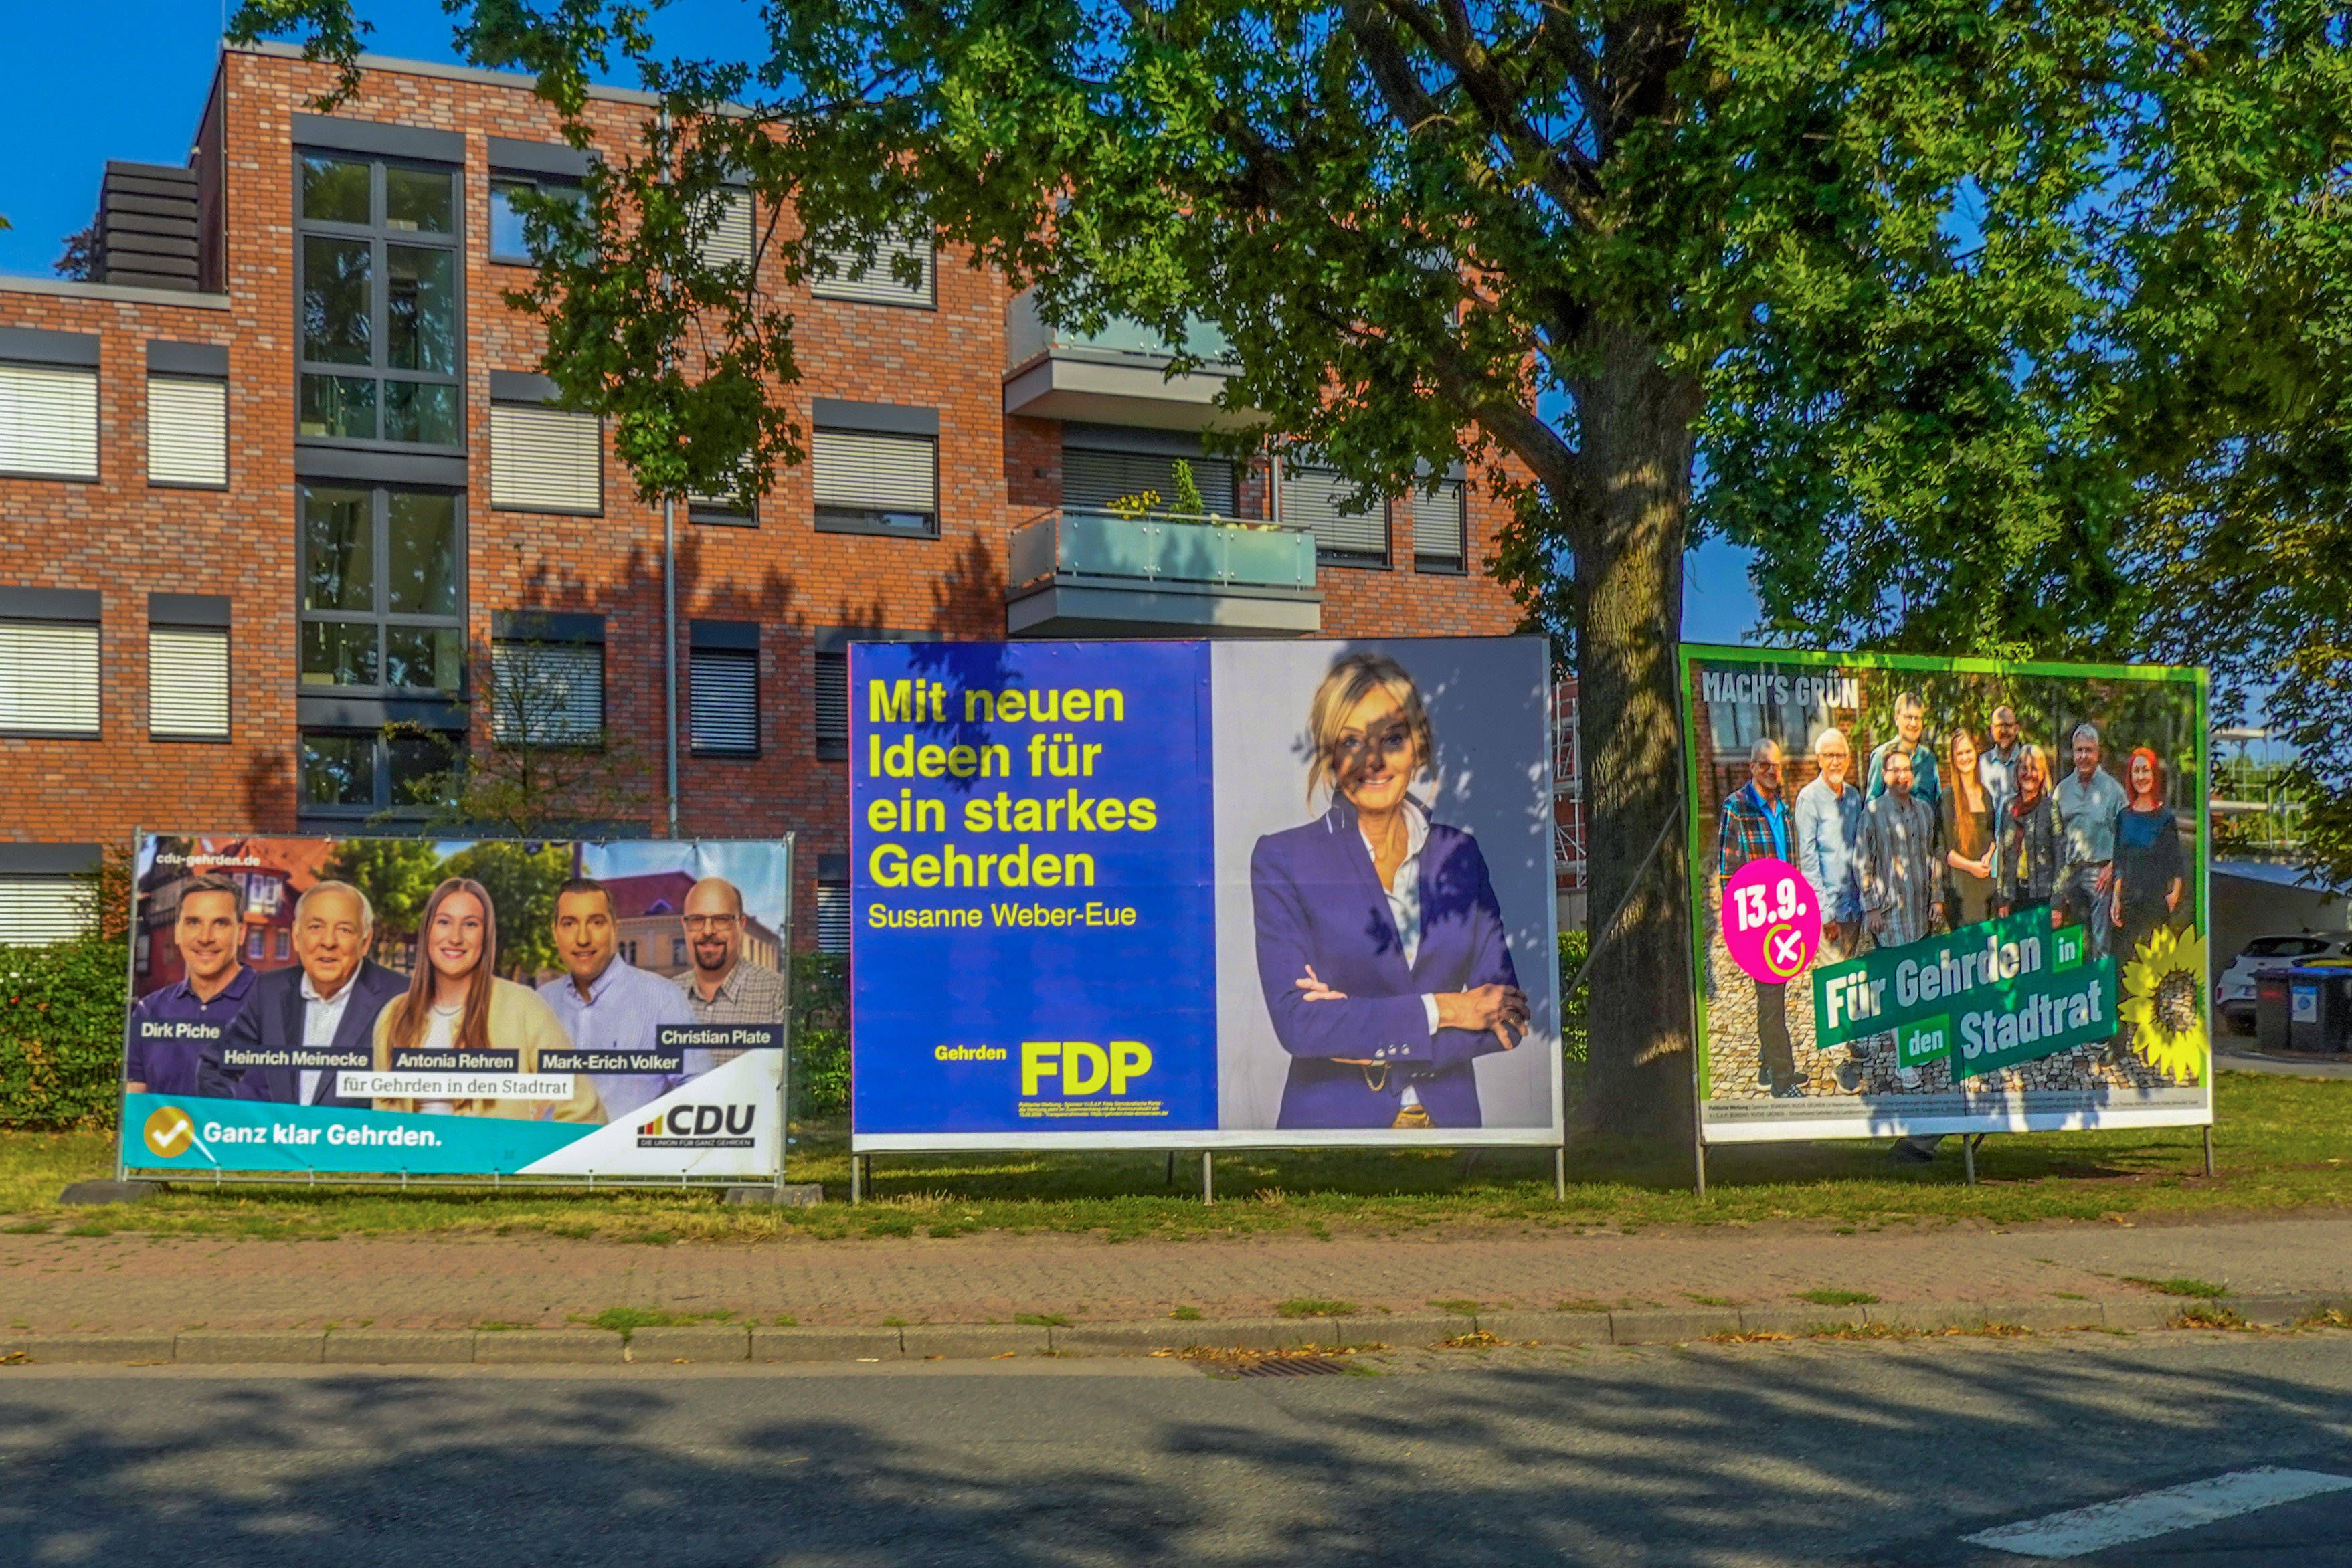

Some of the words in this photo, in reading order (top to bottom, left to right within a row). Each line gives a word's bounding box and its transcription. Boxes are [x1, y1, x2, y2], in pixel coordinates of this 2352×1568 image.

[869, 678, 947, 723] Mit
[964, 688, 1124, 723] neuen
[1702, 671, 1789, 705] MACH'S
[1795, 668, 1859, 709] GRÜN
[869, 733, 1010, 777] Ideen
[1027, 732, 1103, 777] für
[867, 787, 945, 833] ein
[964, 787, 1158, 832] starkes
[155, 853, 261, 868] cdu-gehrden.de
[869, 842, 1095, 888] Gehrden
[868, 903, 982, 928] Susanne
[990, 902, 1137, 927] Weber-Eue
[1734, 878, 1807, 932] 13.9.
[1825, 970, 1886, 1030] Für
[1895, 934, 2042, 1007] Gehrden
[2058, 938, 2076, 964] in
[141, 1022, 173, 1038] Dirk
[176, 1023, 221, 1039] Piche
[1908, 1029, 1944, 1058] den
[1960, 979, 2103, 1060] Stadtrat
[661, 1030, 729, 1044] Christian
[732, 1030, 771, 1044] Plate
[224, 1049, 289, 1065] Heinrich
[292, 1050, 369, 1067] Meinecke
[396, 1053, 456, 1068] Antonia
[458, 1054, 513, 1069] Rehren
[542, 1054, 628, 1070] Mark-Erich
[630, 1054, 679, 1070] Volker
[934, 1044, 1007, 1061] Gehrden
[1021, 1040, 1153, 1096] FDP
[343, 1076, 367, 1092] für
[371, 1078, 442, 1093] Gehrden
[447, 1078, 462, 1093] in
[467, 1078, 498, 1094] den
[502, 1079, 567, 1094] Stadtrat
[203, 1122, 267, 1144] Ganz
[272, 1123, 322, 1145] klar
[327, 1124, 443, 1147] Gehrden.
[666, 1104, 756, 1135] CDU
